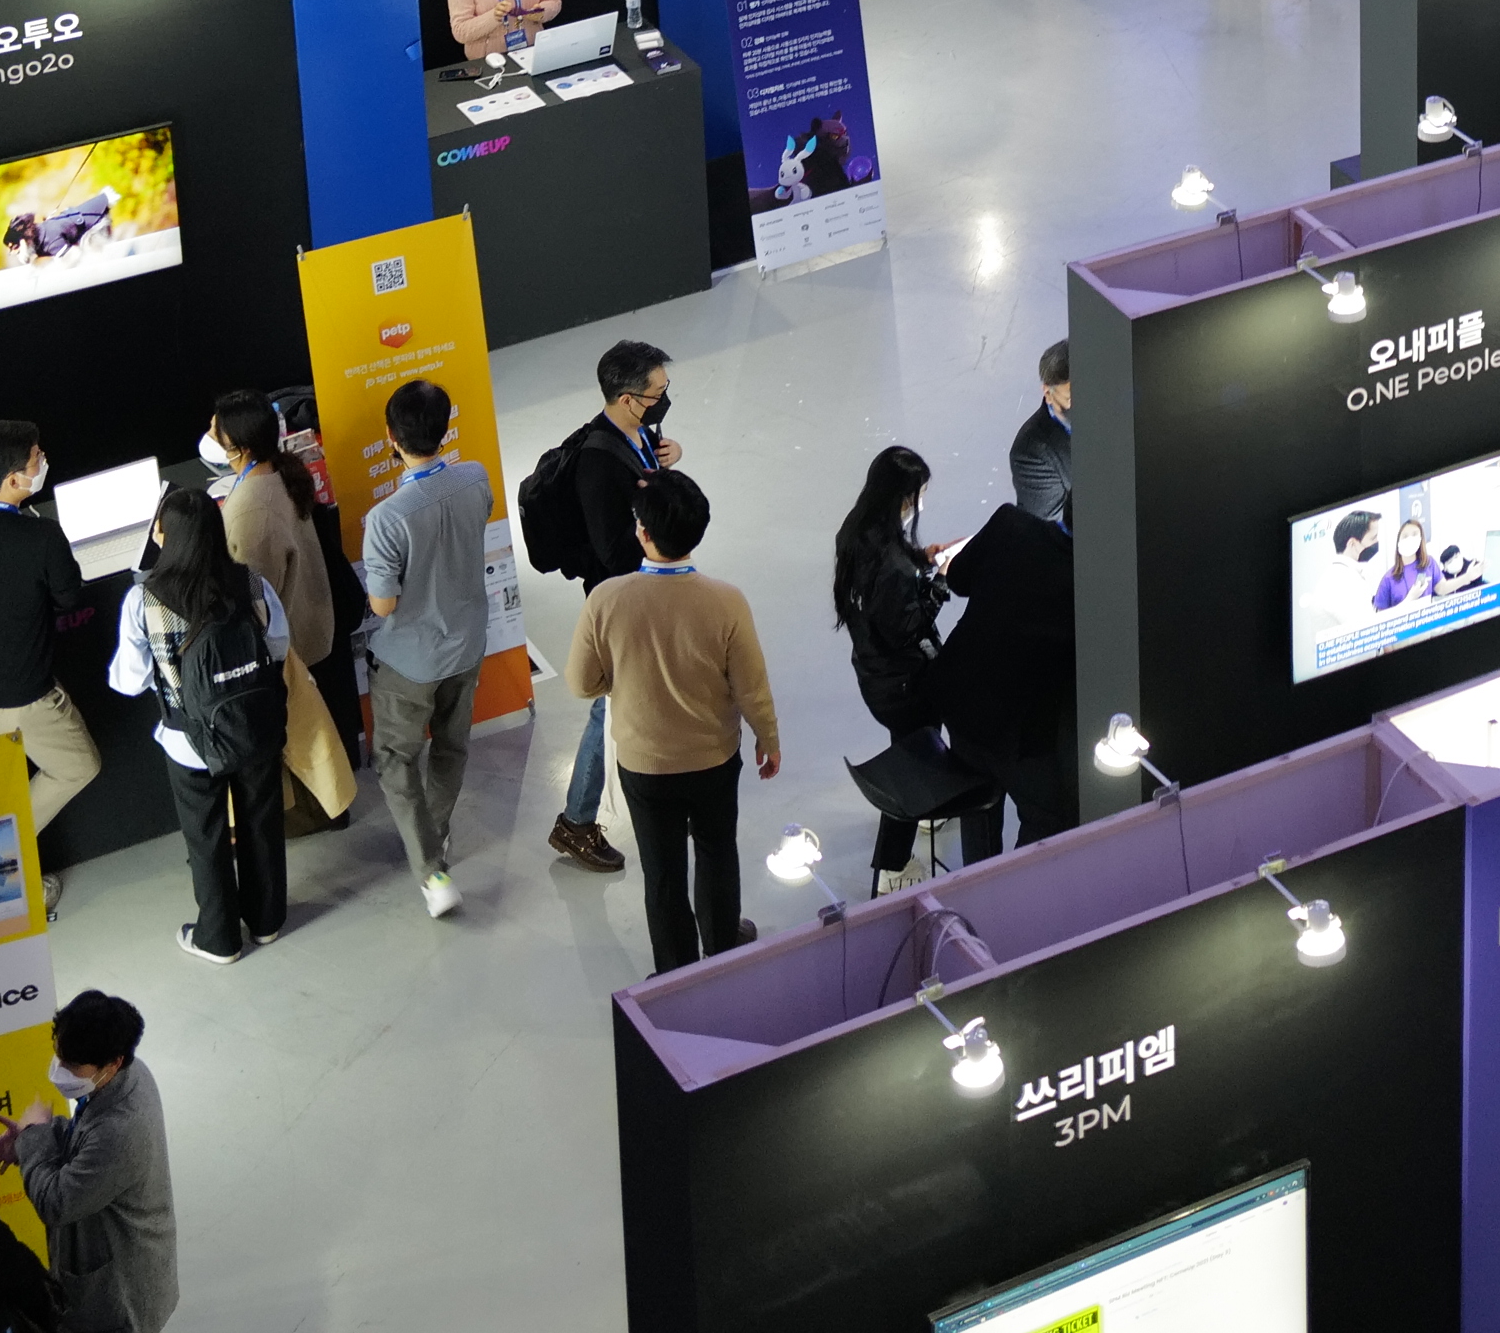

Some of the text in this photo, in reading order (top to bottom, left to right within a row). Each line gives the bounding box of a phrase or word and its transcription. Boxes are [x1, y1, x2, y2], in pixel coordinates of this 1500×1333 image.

[436, 135, 512, 167] COMEUP
[381, 321, 411, 340] petp
[1368, 309, 1486, 375] 오내피플
[1347, 369, 1410, 412] O.NE
[1015, 1024, 1177, 1123] 쓰리피엠
[1053, 1094, 1133, 1149] 3PM
